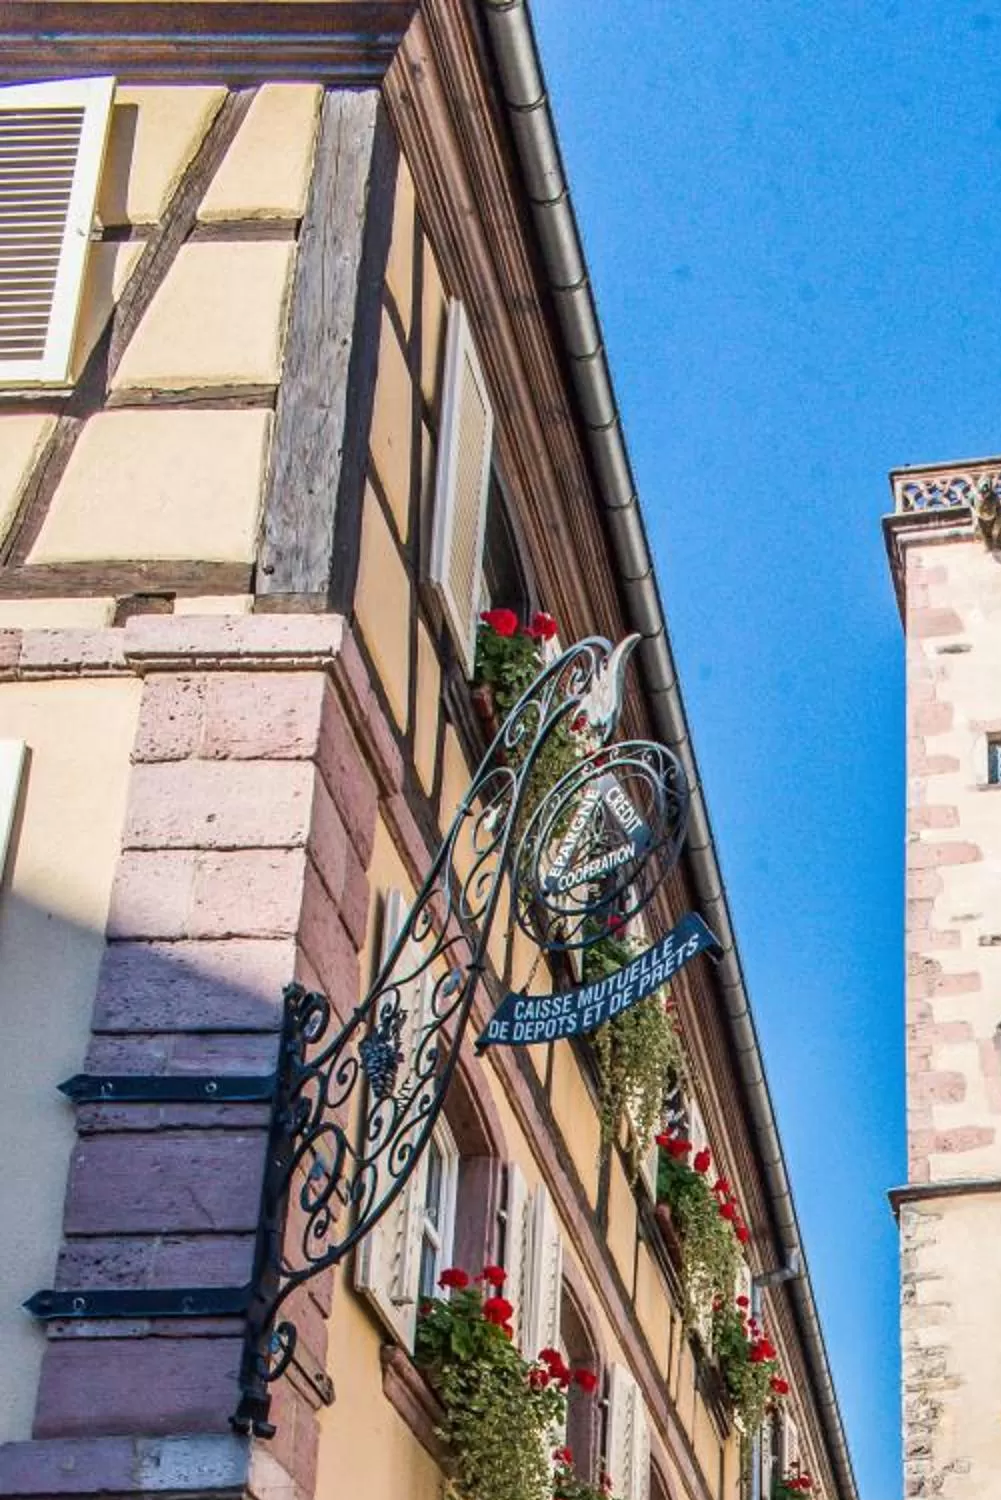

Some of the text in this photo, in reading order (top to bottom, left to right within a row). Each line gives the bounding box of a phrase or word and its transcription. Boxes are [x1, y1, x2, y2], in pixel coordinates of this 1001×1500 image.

[548, 789, 601, 877] EPARGNE
[606, 786, 643, 835] CREDIT
[557, 841, 636, 891] COOPERATION
[513, 934, 675, 1020] CAISSE MUTUELLE
[488, 1020, 510, 1041] DE
[512, 1012, 578, 1042] DEPOTS
[583, 1002, 607, 1027] ET
[609, 988, 633, 1015] DE
